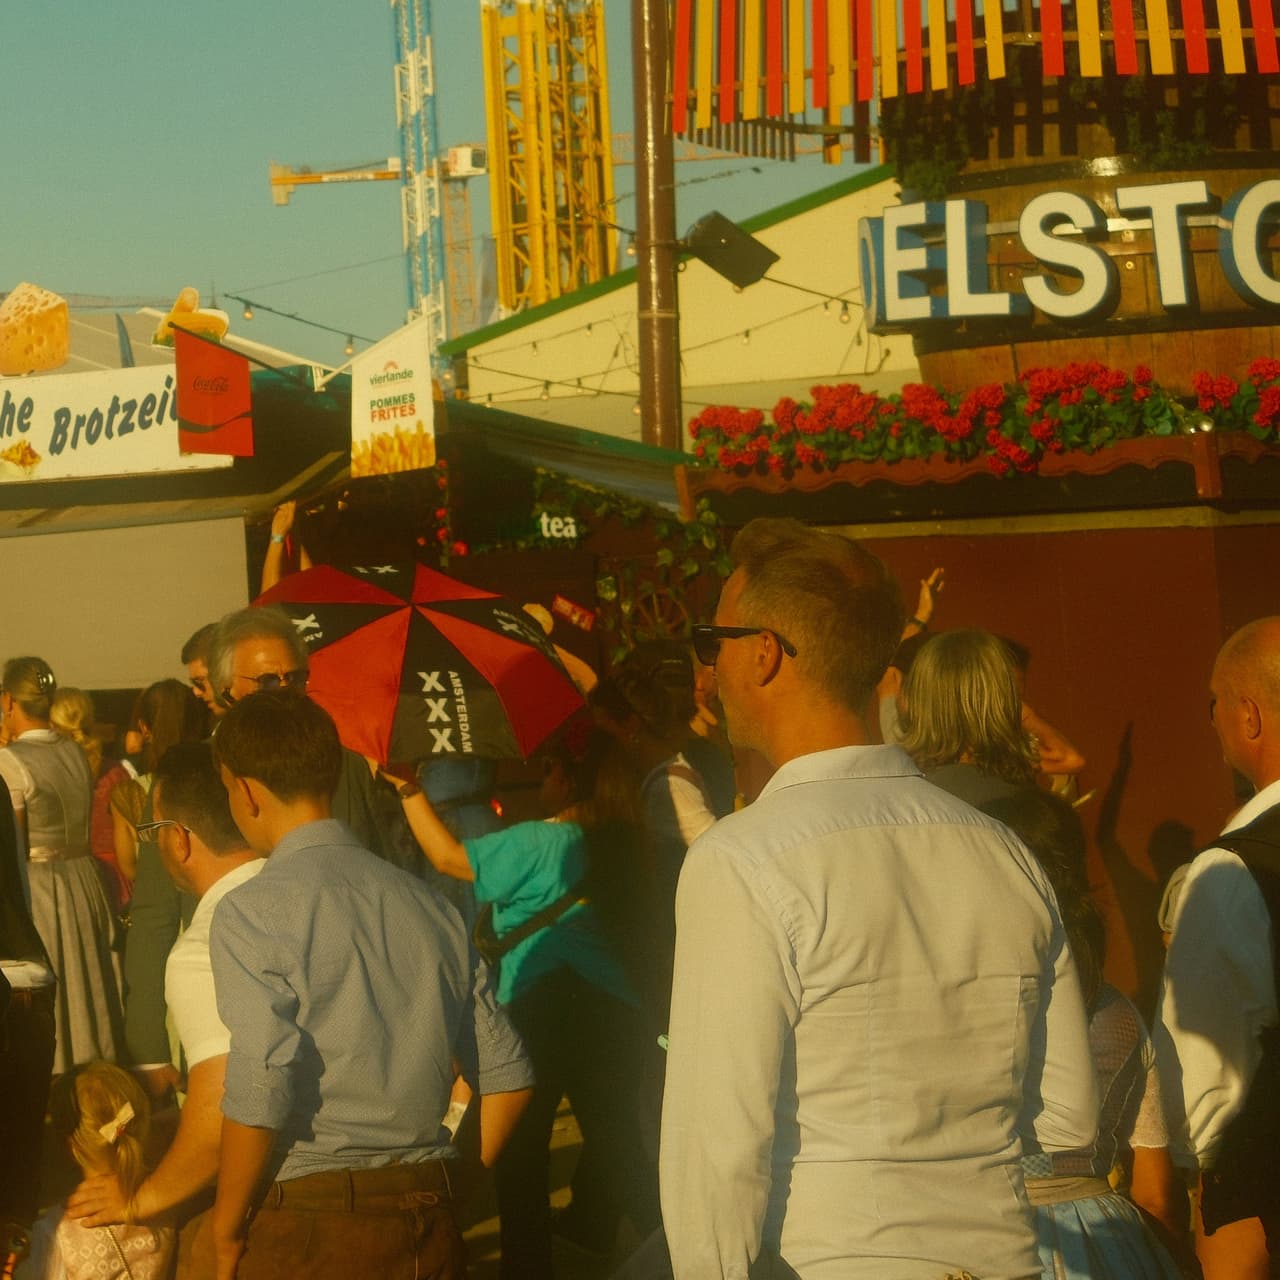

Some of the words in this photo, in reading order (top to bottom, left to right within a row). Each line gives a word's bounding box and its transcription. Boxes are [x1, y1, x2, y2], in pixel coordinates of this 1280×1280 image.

[369, 368, 414, 385] vierlande
[369, 392, 416, 409] POMMES
[370, 403, 417, 422] FRITES
[540, 512, 577, 538] tea
[447, 670, 474, 754] AMSTERDAM
